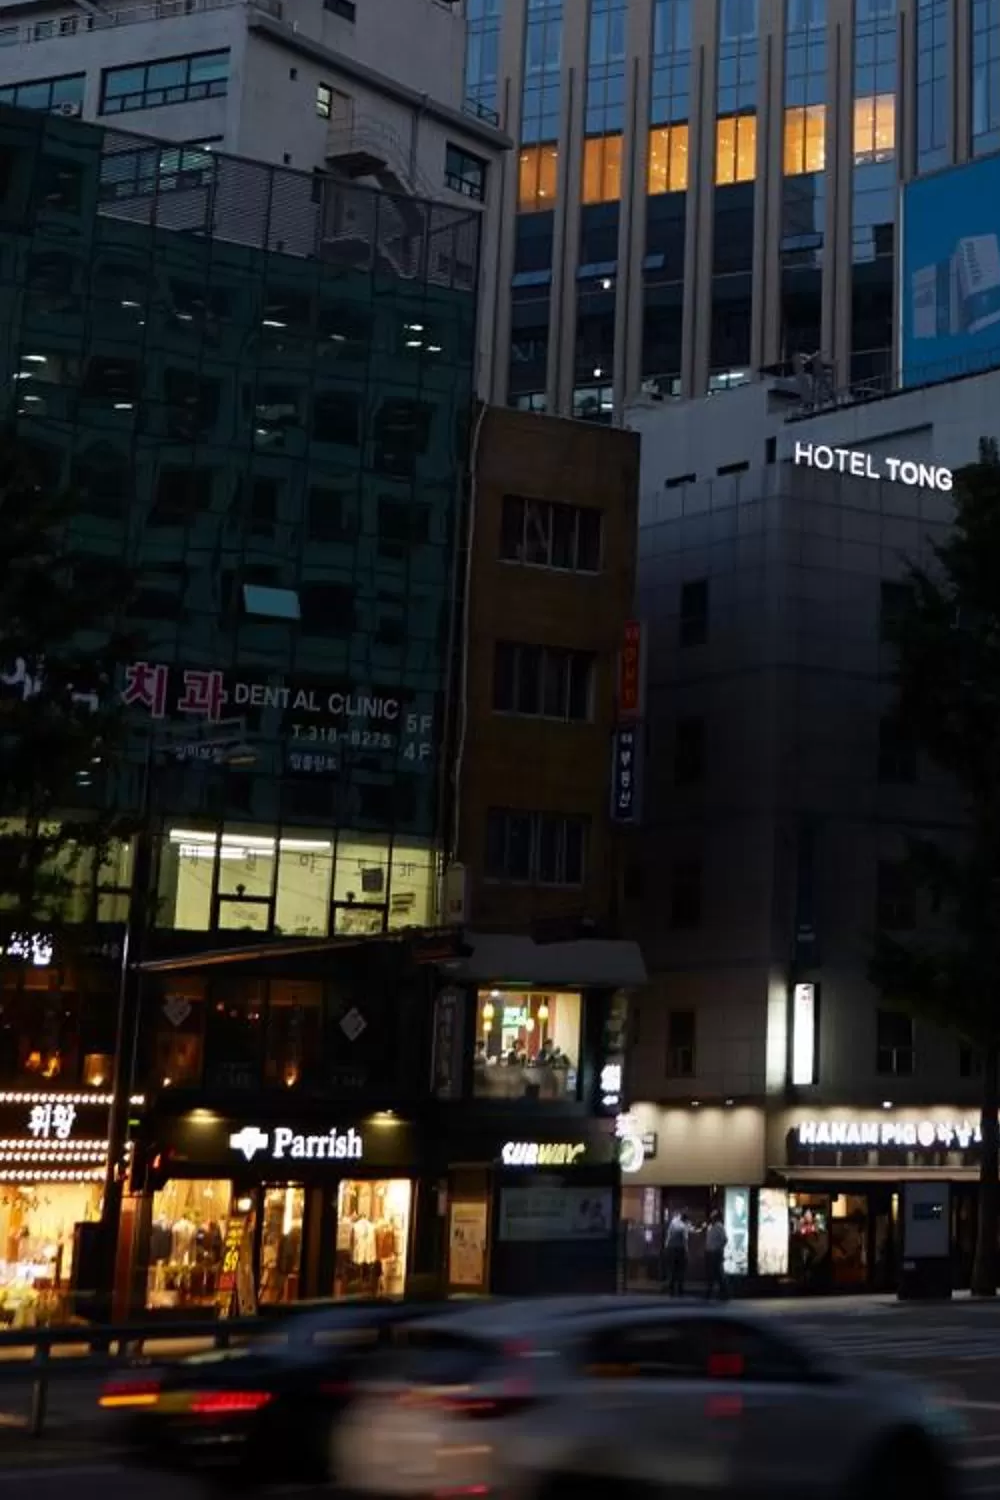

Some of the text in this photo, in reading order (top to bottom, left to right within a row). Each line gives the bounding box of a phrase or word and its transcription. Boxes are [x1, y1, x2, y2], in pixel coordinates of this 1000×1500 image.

[794, 440, 953, 492] HOTEL TONG
[120, 660, 229, 724] 치과
[234, 681, 400, 721] DENTAL CLINIC
[406, 712, 433, 734] 5F
[403, 741, 431, 762] 4F
[271, 1126, 363, 1159] Parrish
[799, 1120, 880, 1145] HANAM
[502, 1141, 586, 1165] SUBWAY
